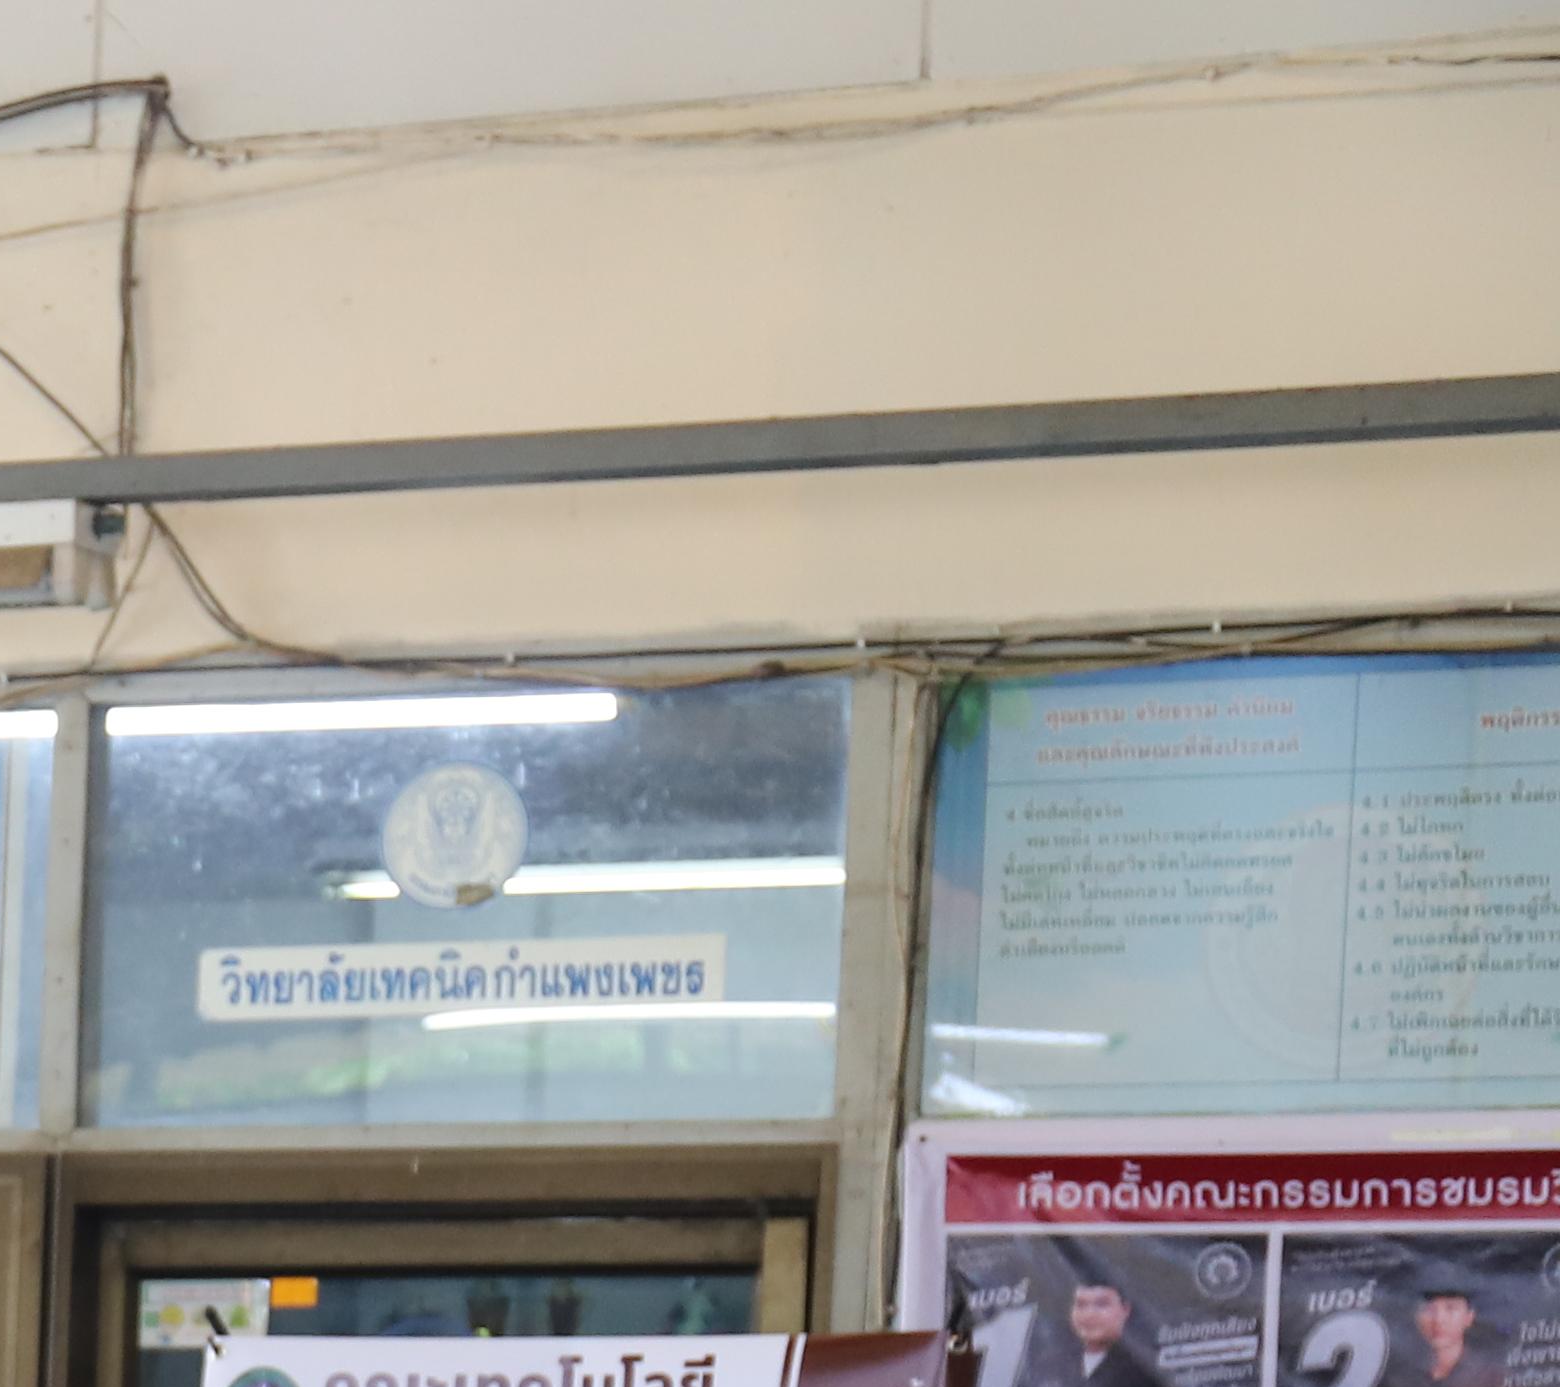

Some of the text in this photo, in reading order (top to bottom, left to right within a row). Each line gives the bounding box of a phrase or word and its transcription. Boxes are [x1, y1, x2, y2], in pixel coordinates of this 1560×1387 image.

[220, 947, 706, 1006] วิทยาลัยเทคนิคกำแพงเพชร
